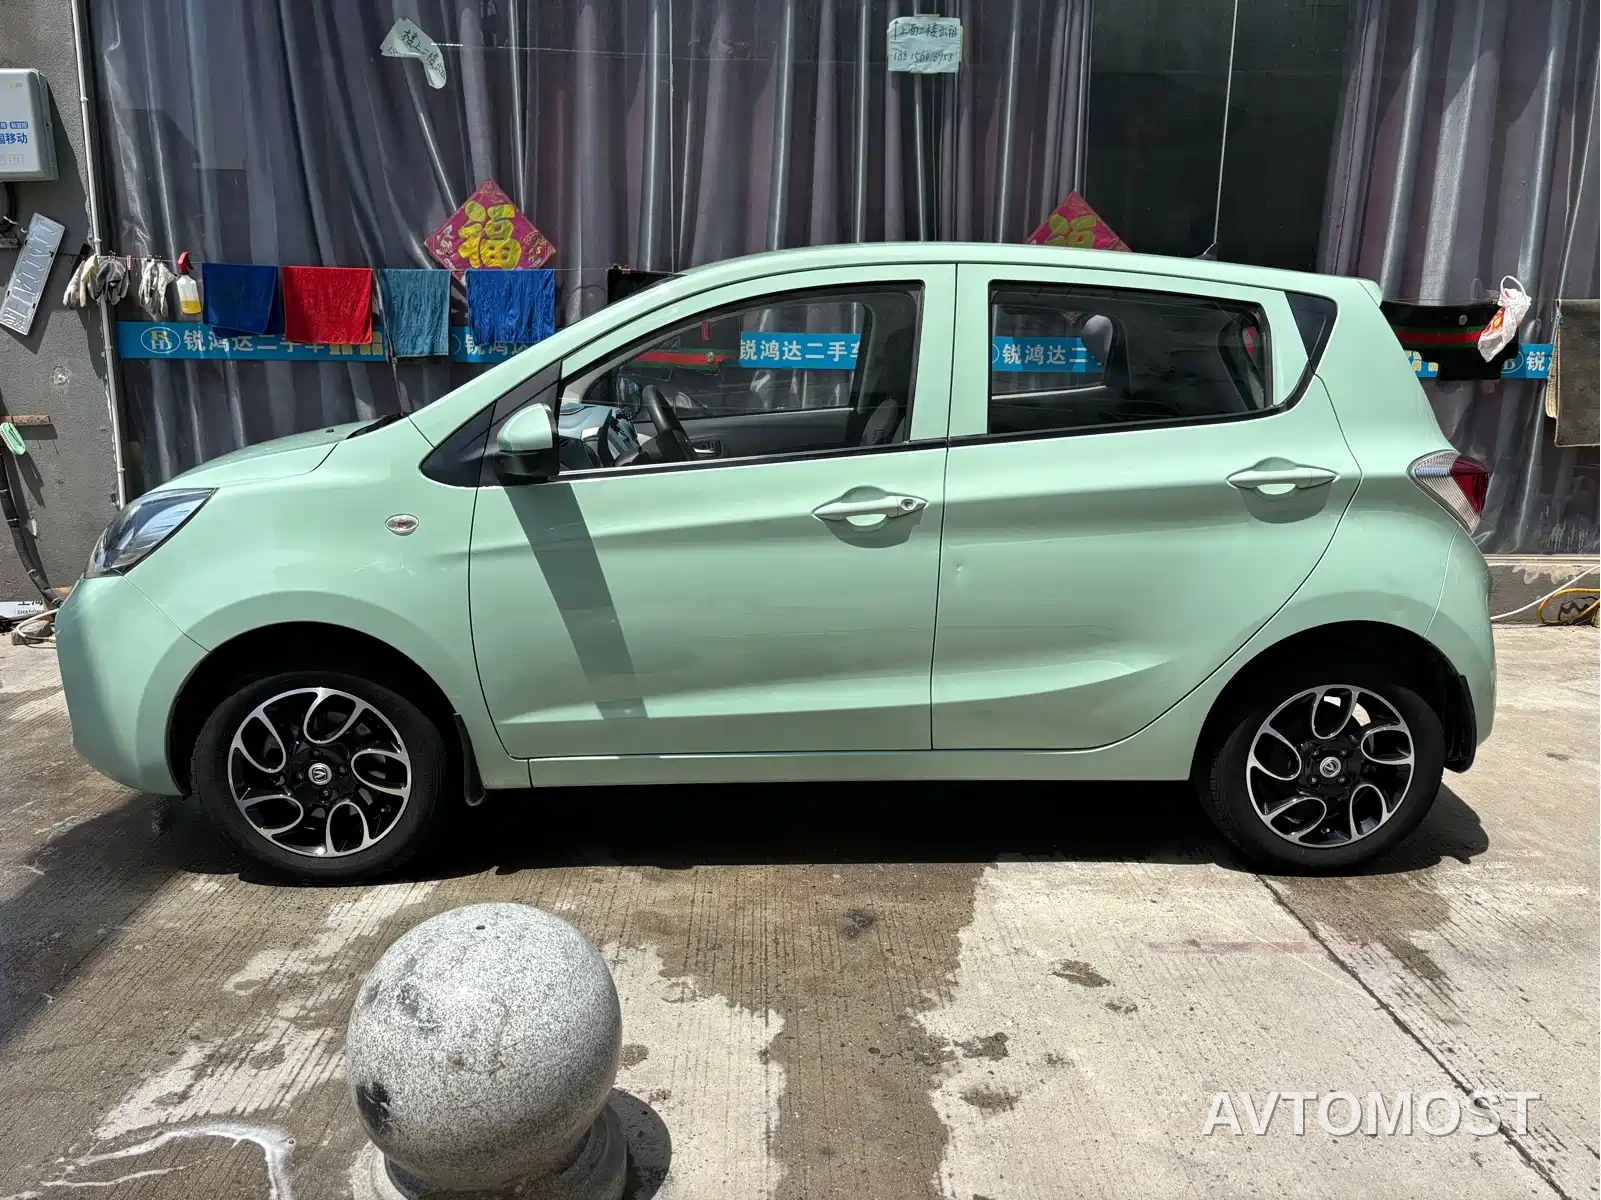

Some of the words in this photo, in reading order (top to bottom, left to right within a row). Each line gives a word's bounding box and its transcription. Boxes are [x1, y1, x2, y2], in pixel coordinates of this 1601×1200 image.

[458, 200, 522, 270] 福
[1002, 343, 1101, 366] 锐鸿达二
[1526, 350, 1552, 372] 锐
